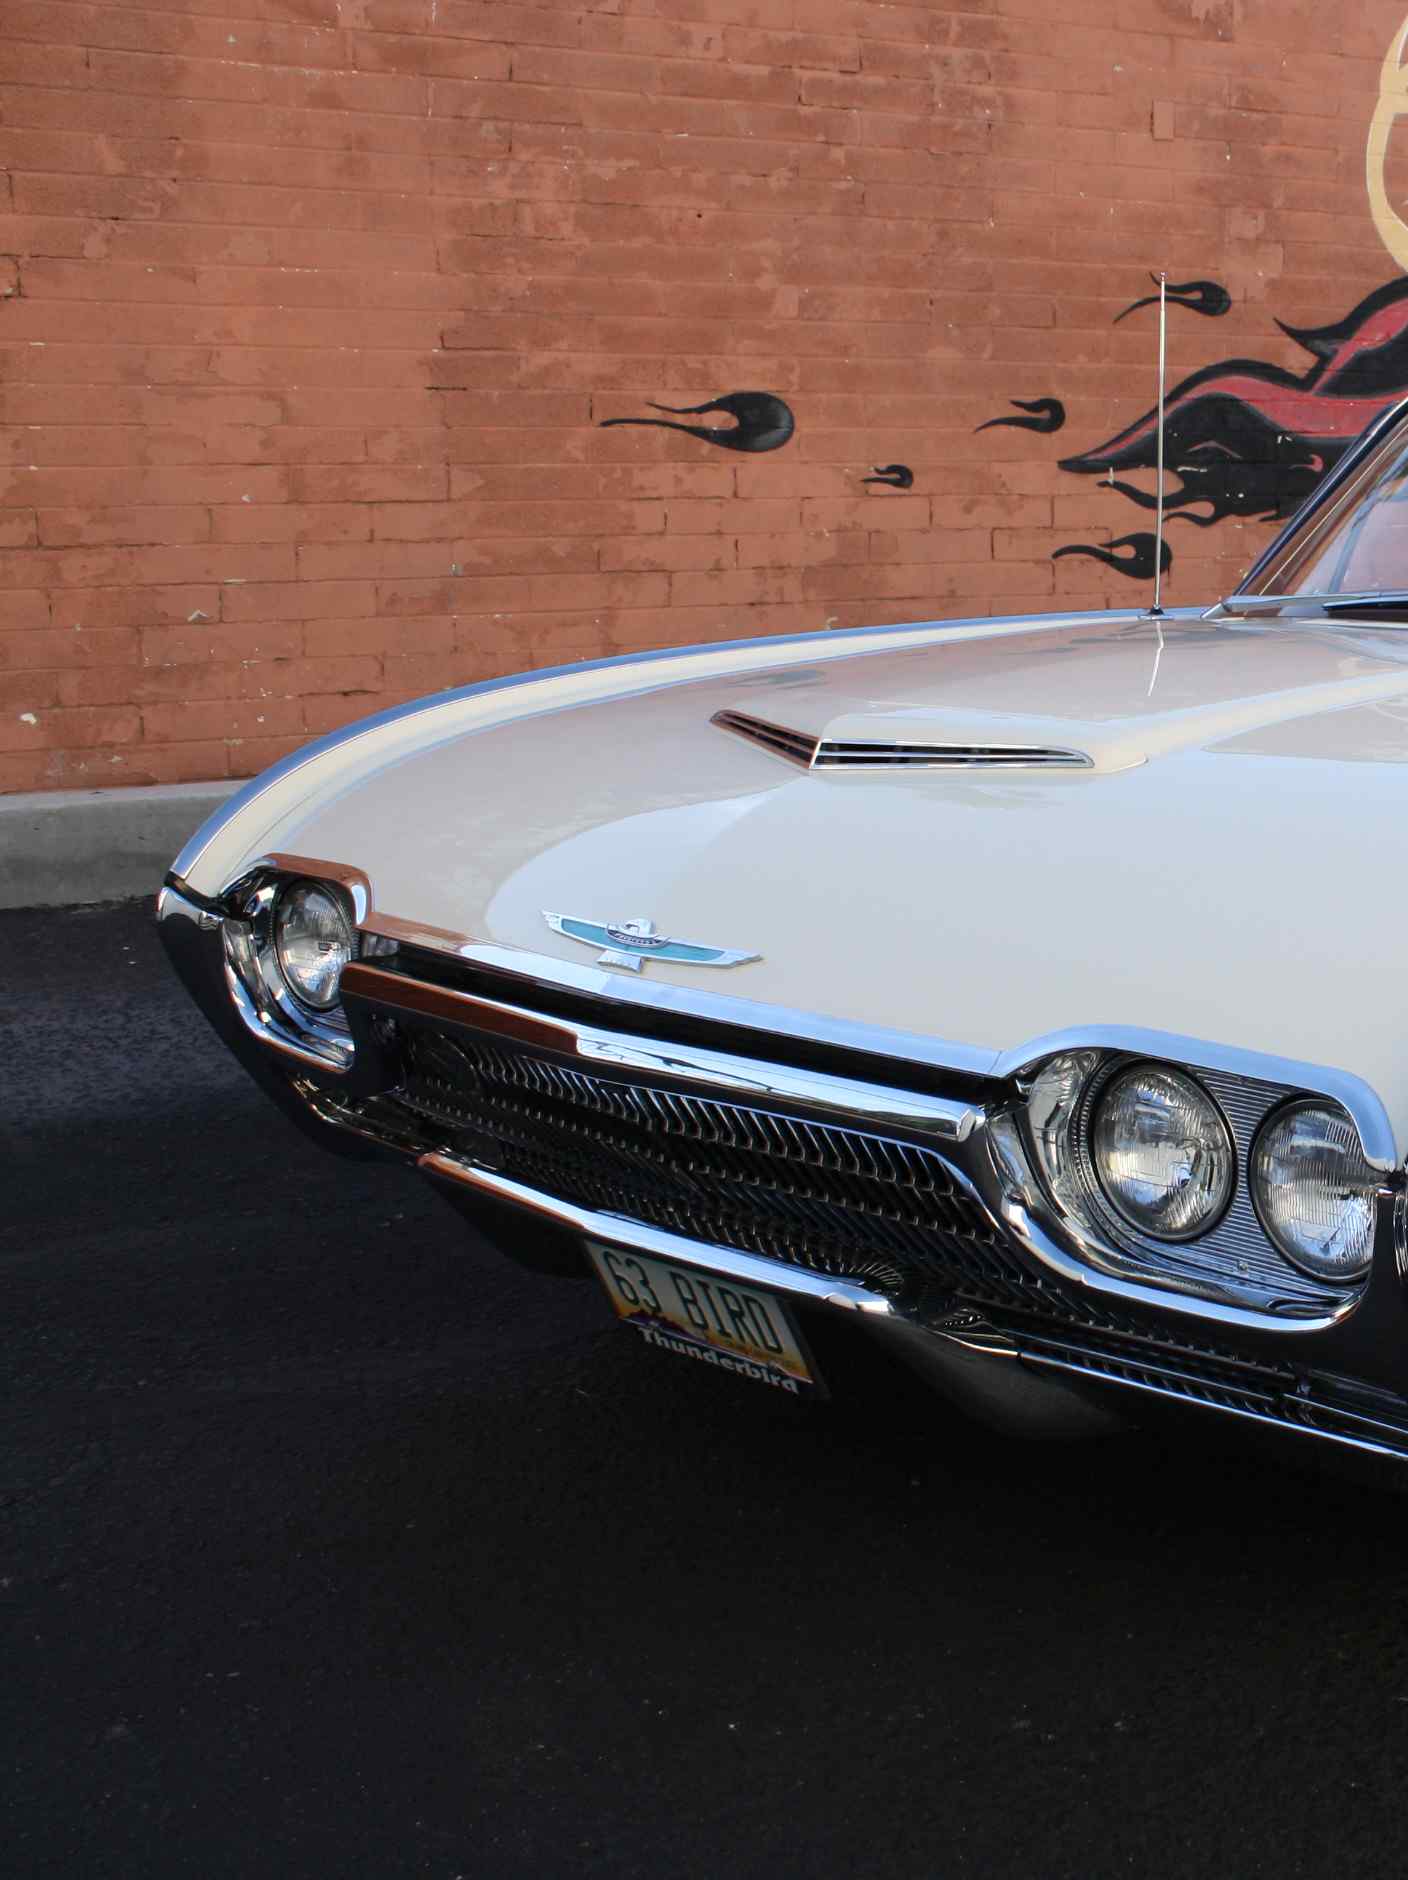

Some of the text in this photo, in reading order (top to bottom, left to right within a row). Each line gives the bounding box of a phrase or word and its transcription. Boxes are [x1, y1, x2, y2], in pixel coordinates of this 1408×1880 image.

[603, 1250, 783, 1354] 63 BIRD
[636, 1326, 800, 1395] Thunderbird
